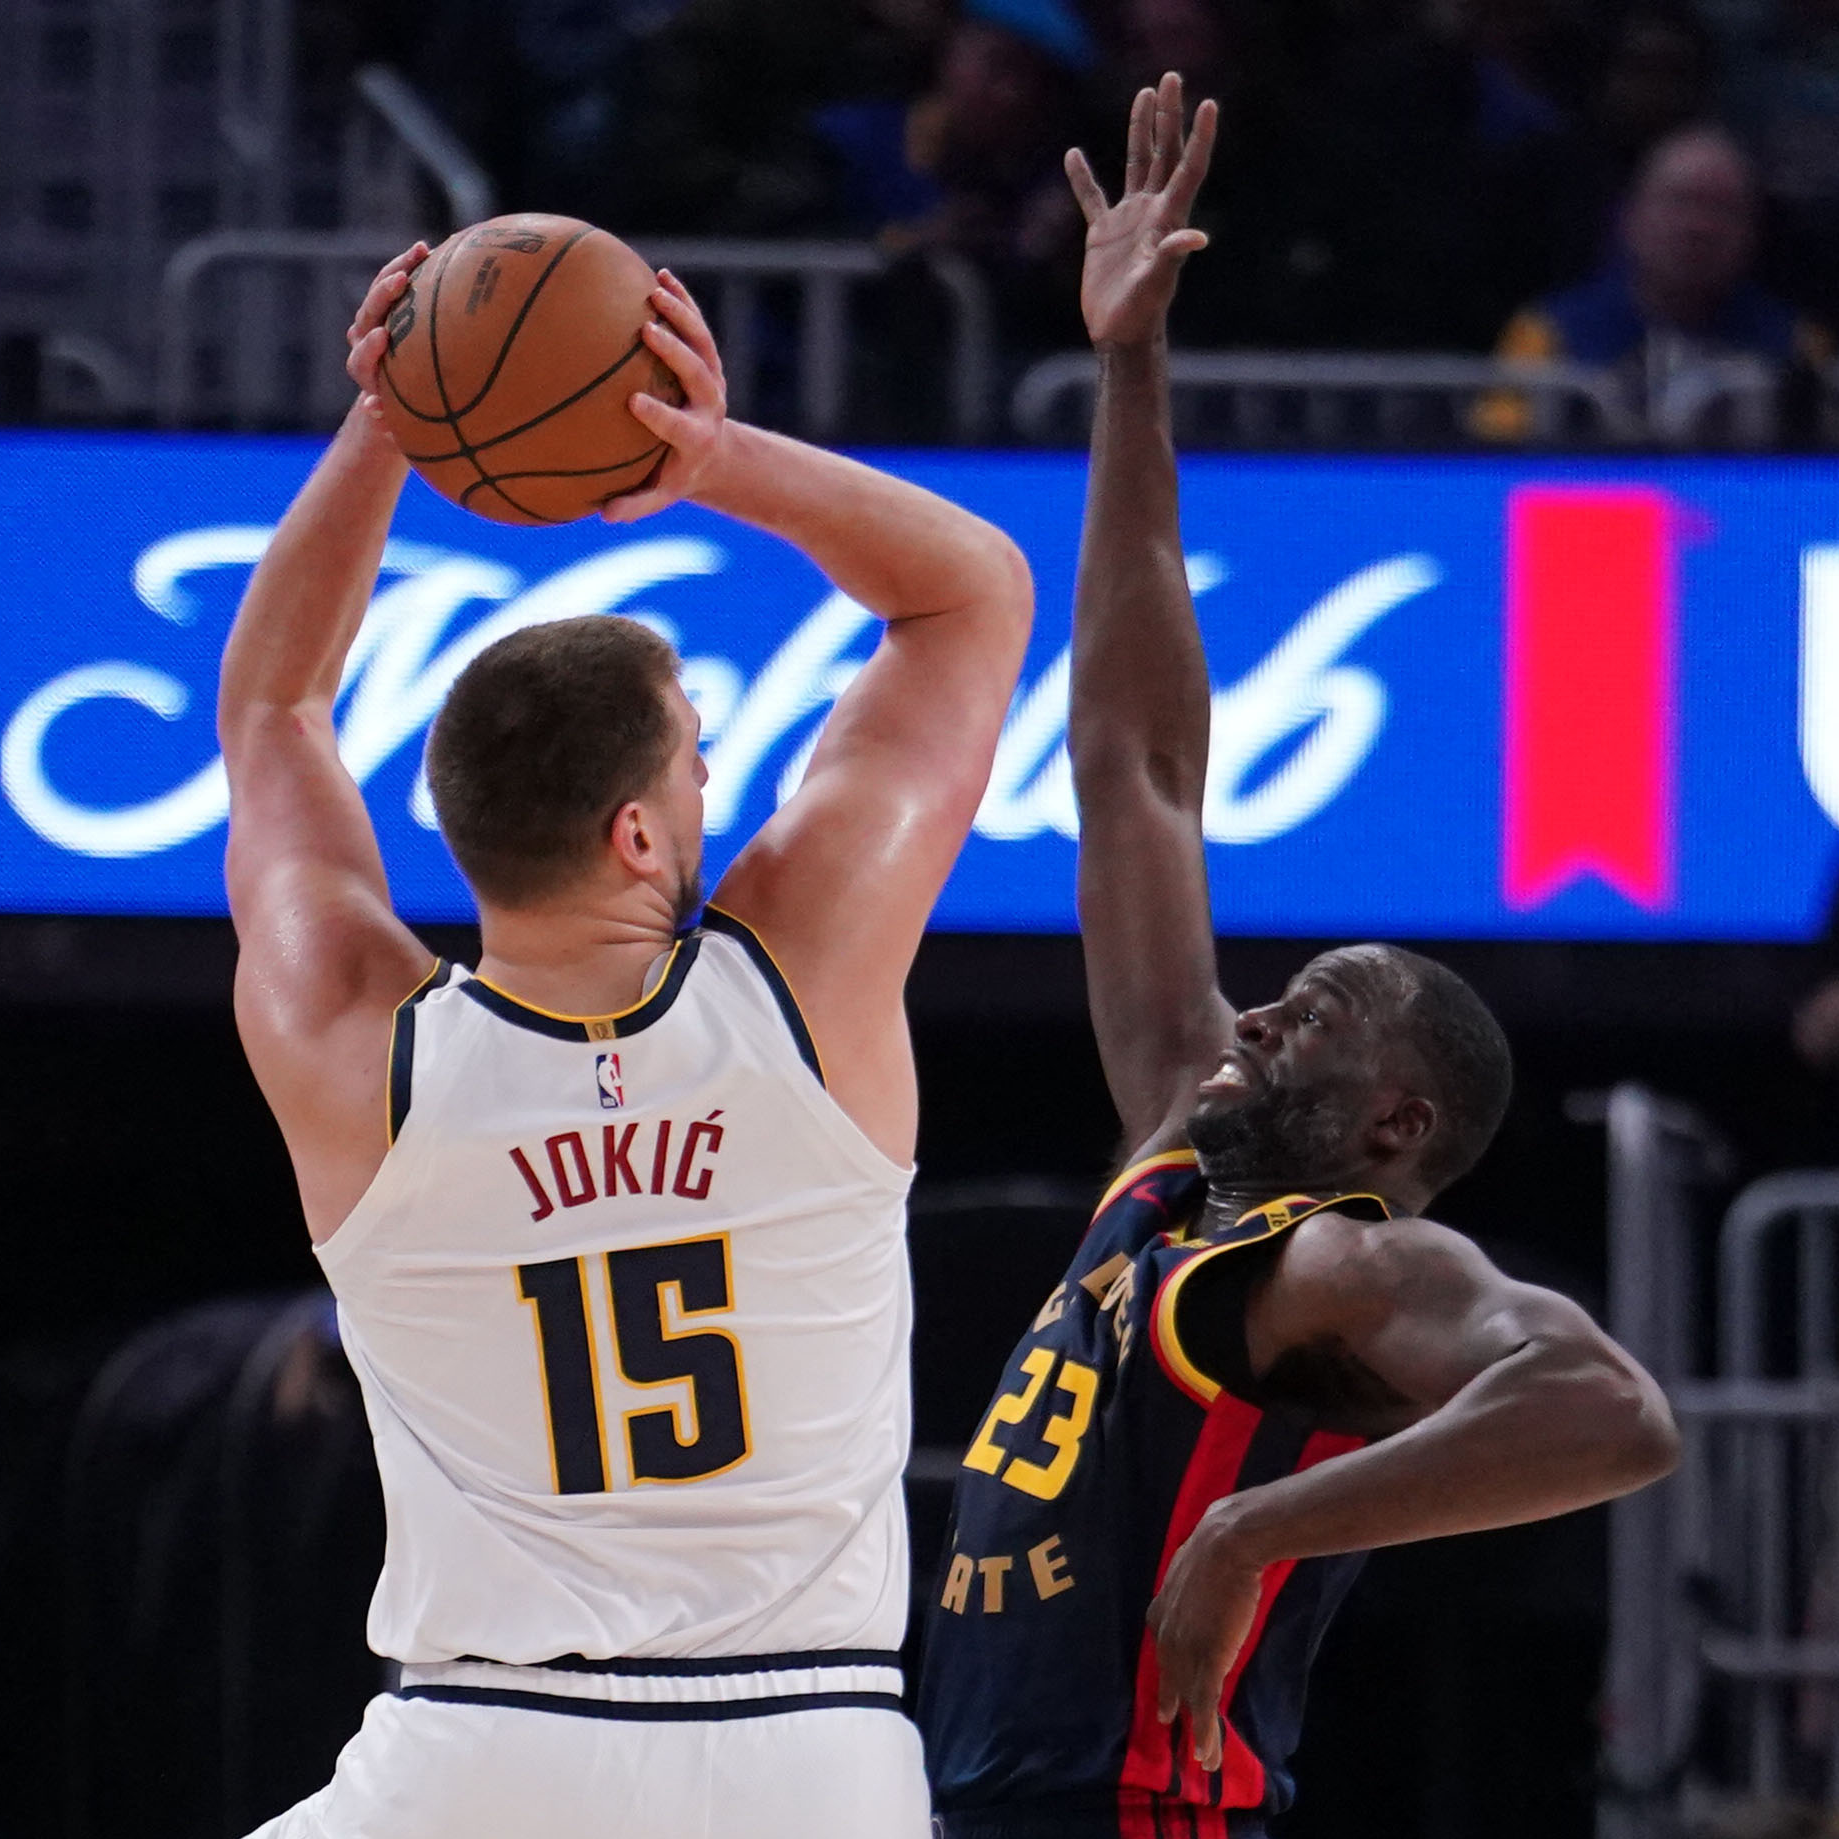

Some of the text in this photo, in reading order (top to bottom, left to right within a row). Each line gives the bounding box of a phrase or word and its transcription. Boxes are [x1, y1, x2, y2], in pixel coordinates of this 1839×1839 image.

[507, 1108, 725, 1223] JOKIĆ
[515, 1230, 752, 1495] 15
[962, 1346, 1099, 1500] 23
[940, 1534, 1076, 1615] ATE
